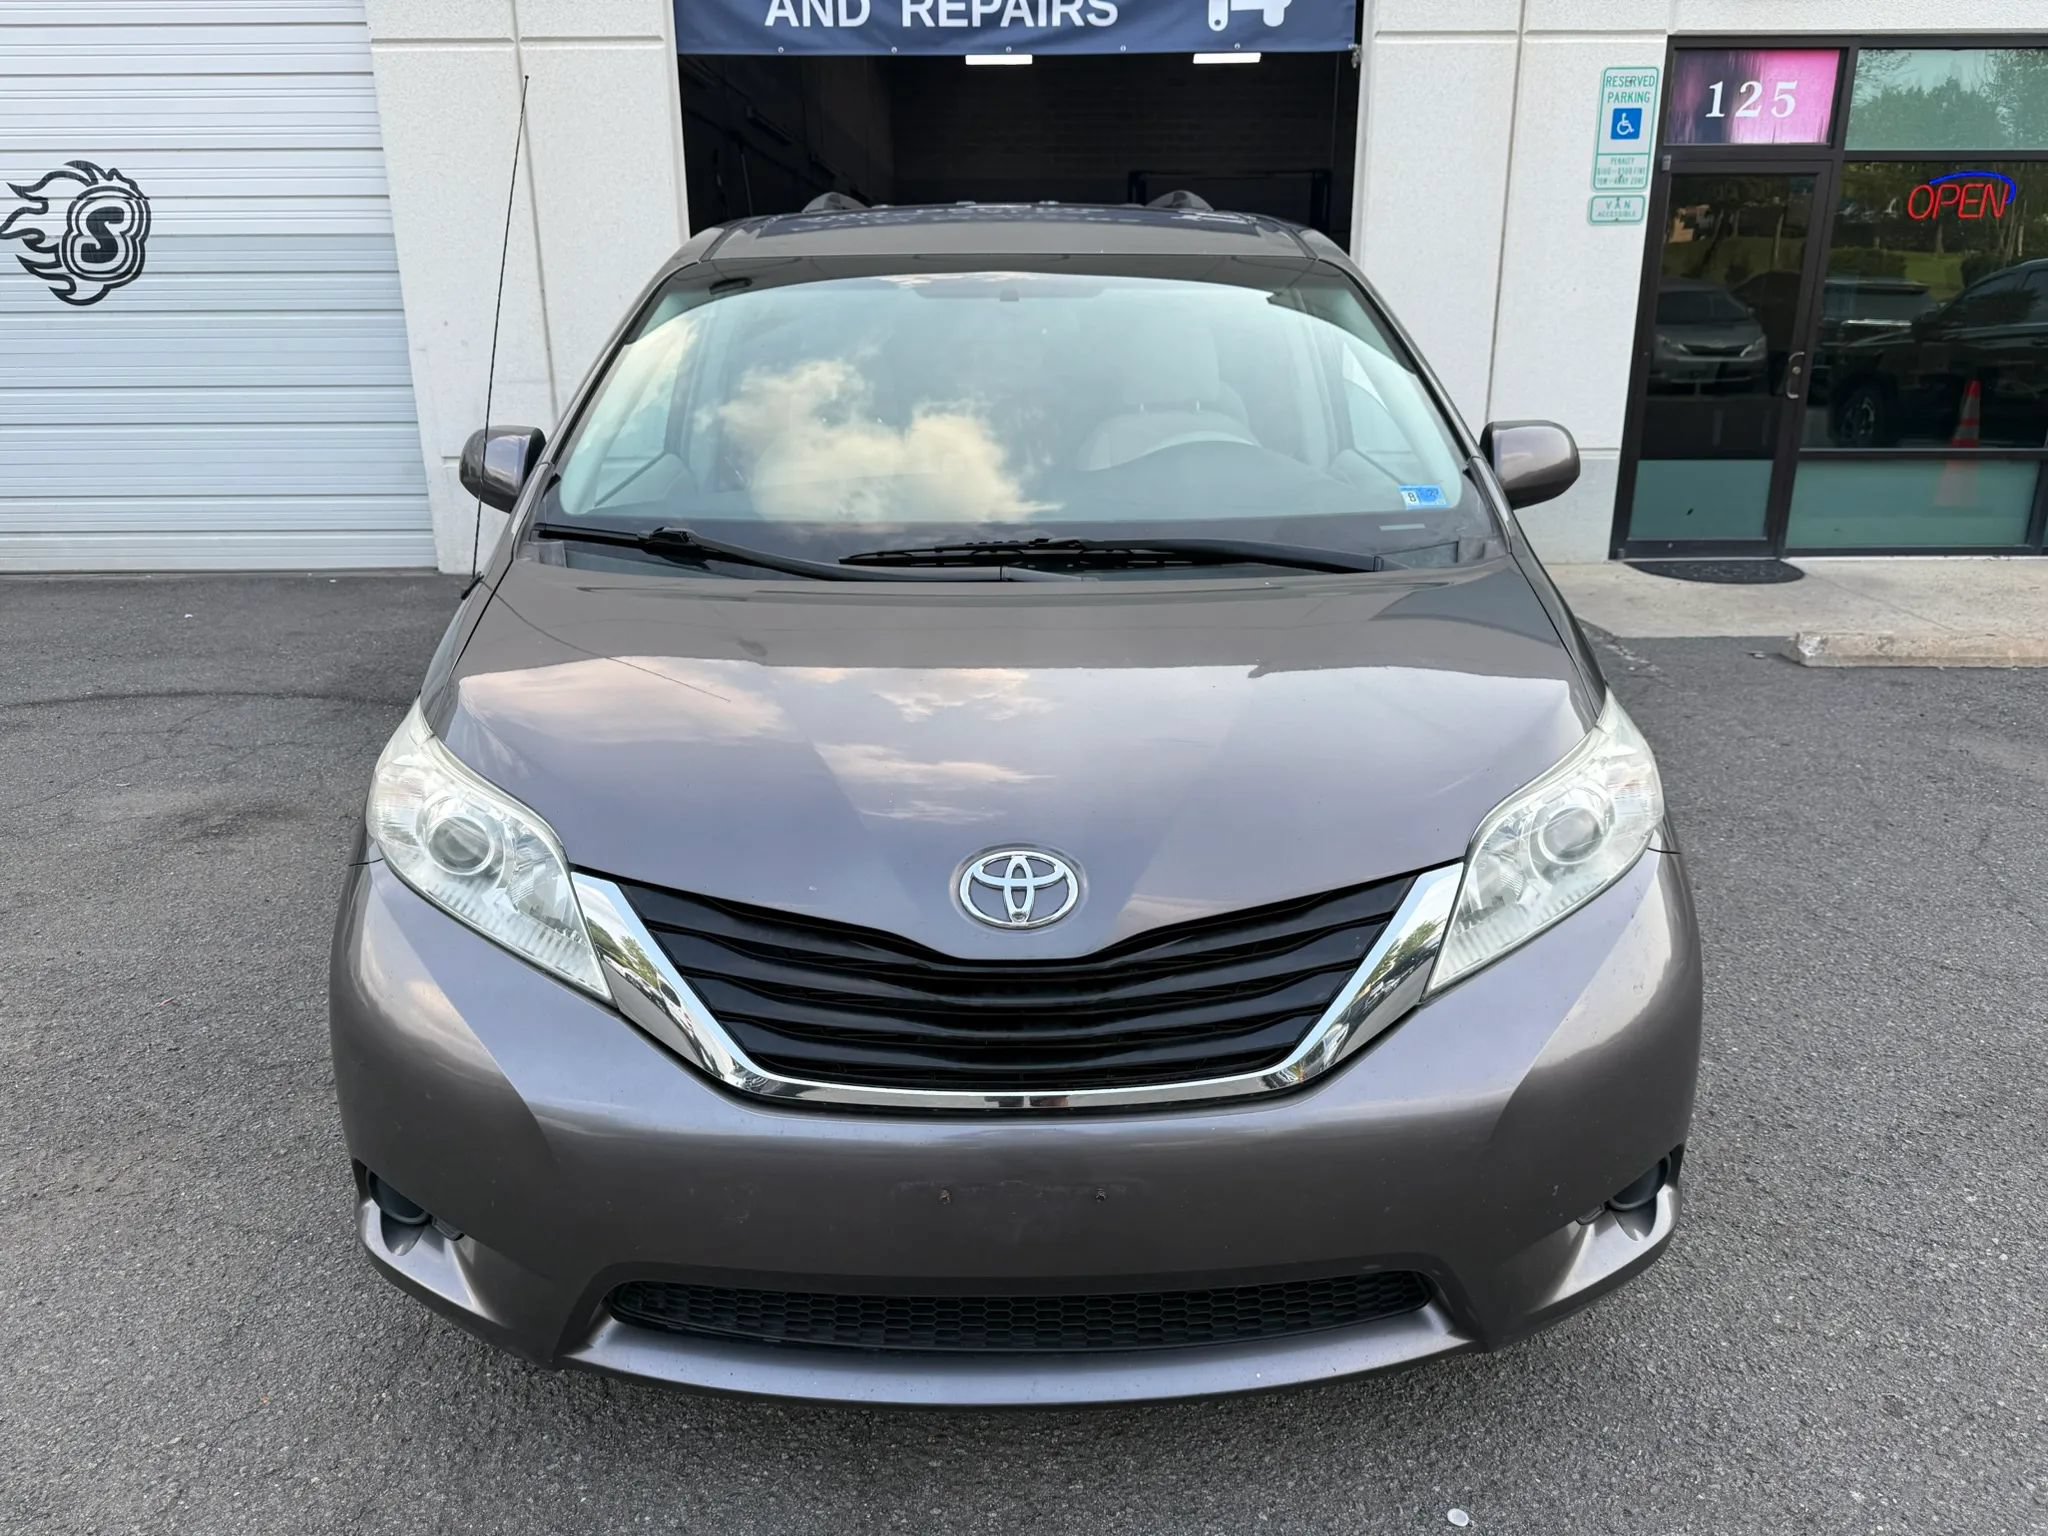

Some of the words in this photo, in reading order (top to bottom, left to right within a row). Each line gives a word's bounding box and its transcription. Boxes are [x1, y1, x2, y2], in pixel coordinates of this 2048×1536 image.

[764, 0, 870, 27] AND
[902, 0, 1118, 27] REPAIRS
[1605, 75, 1656, 88] RESERVED
[1607, 91, 1651, 103] PARKING
[1705, 80, 1798, 119] 125
[1605, 200, 1631, 209] VAN
[1907, 183, 2009, 221] OPEN
